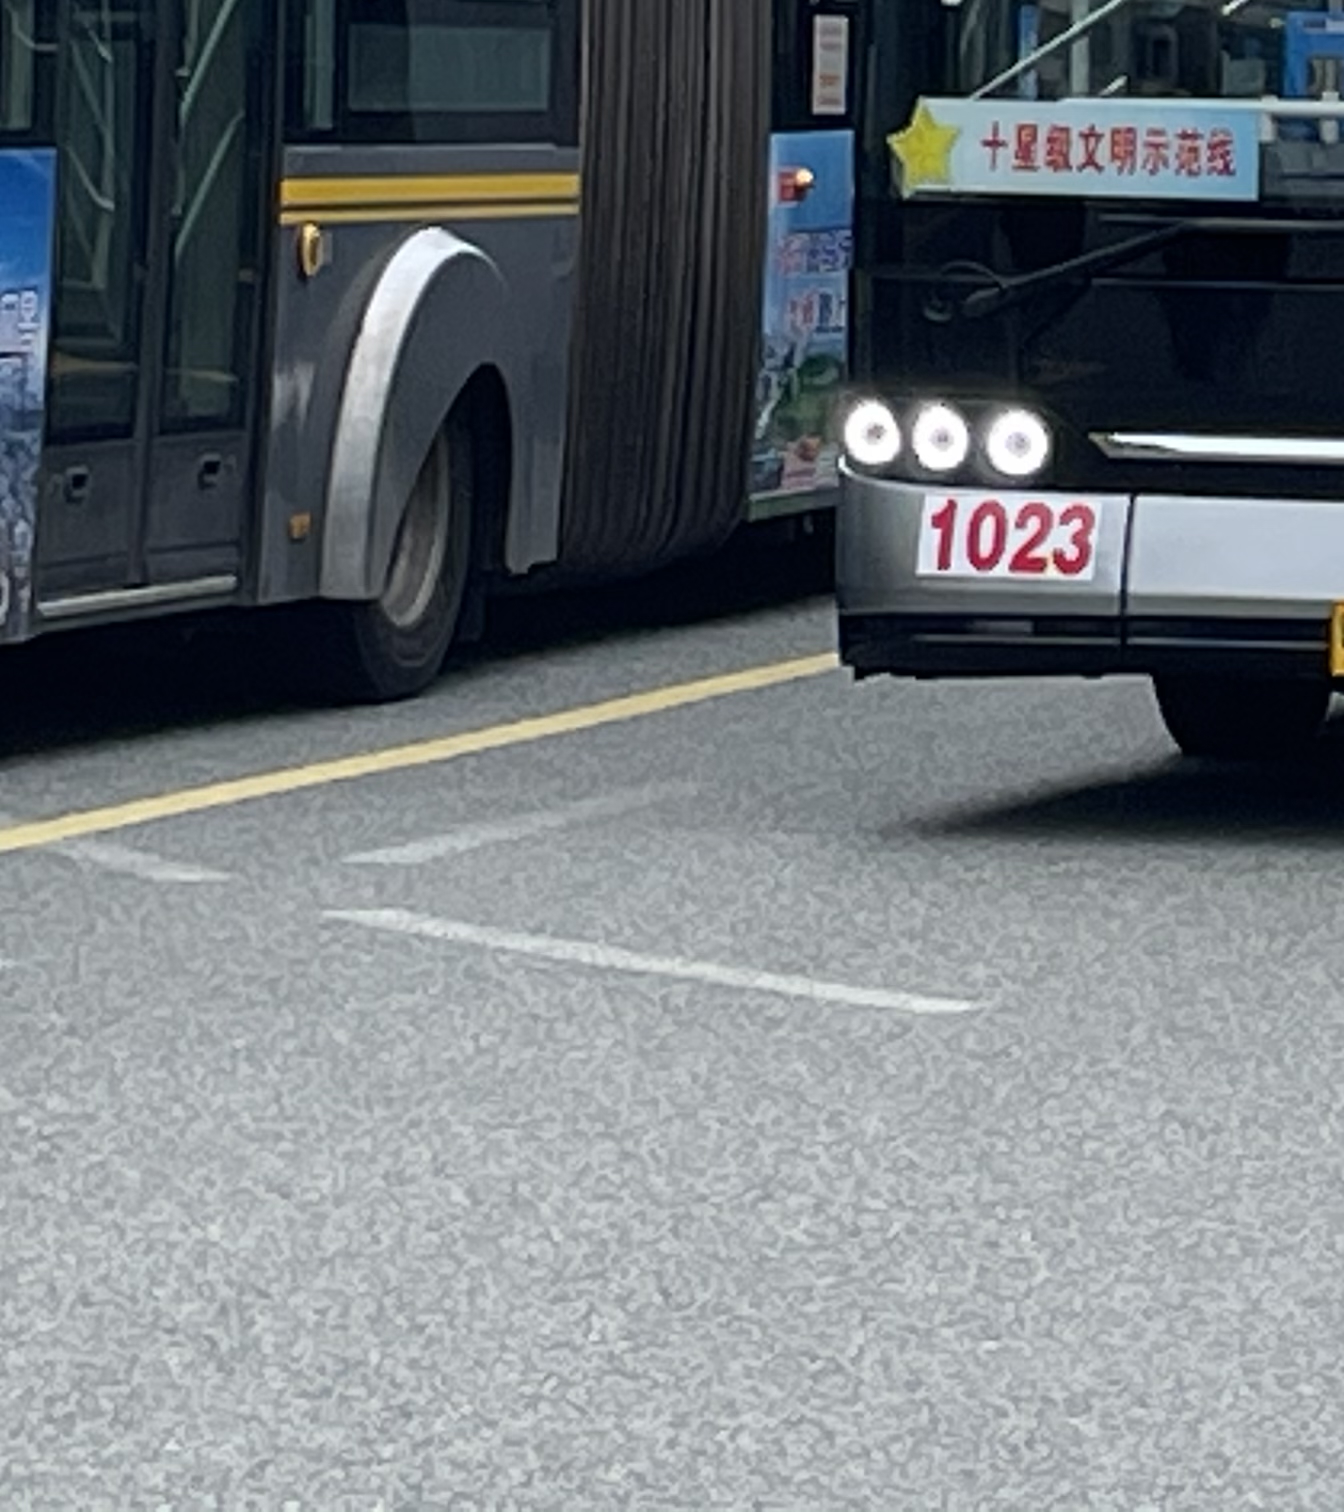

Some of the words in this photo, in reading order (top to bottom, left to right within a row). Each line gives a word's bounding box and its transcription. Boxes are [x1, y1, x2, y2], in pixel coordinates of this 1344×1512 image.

[981, 121, 1236, 177] 十星级文明示范线
[931, 498, 1096, 576] 1023
